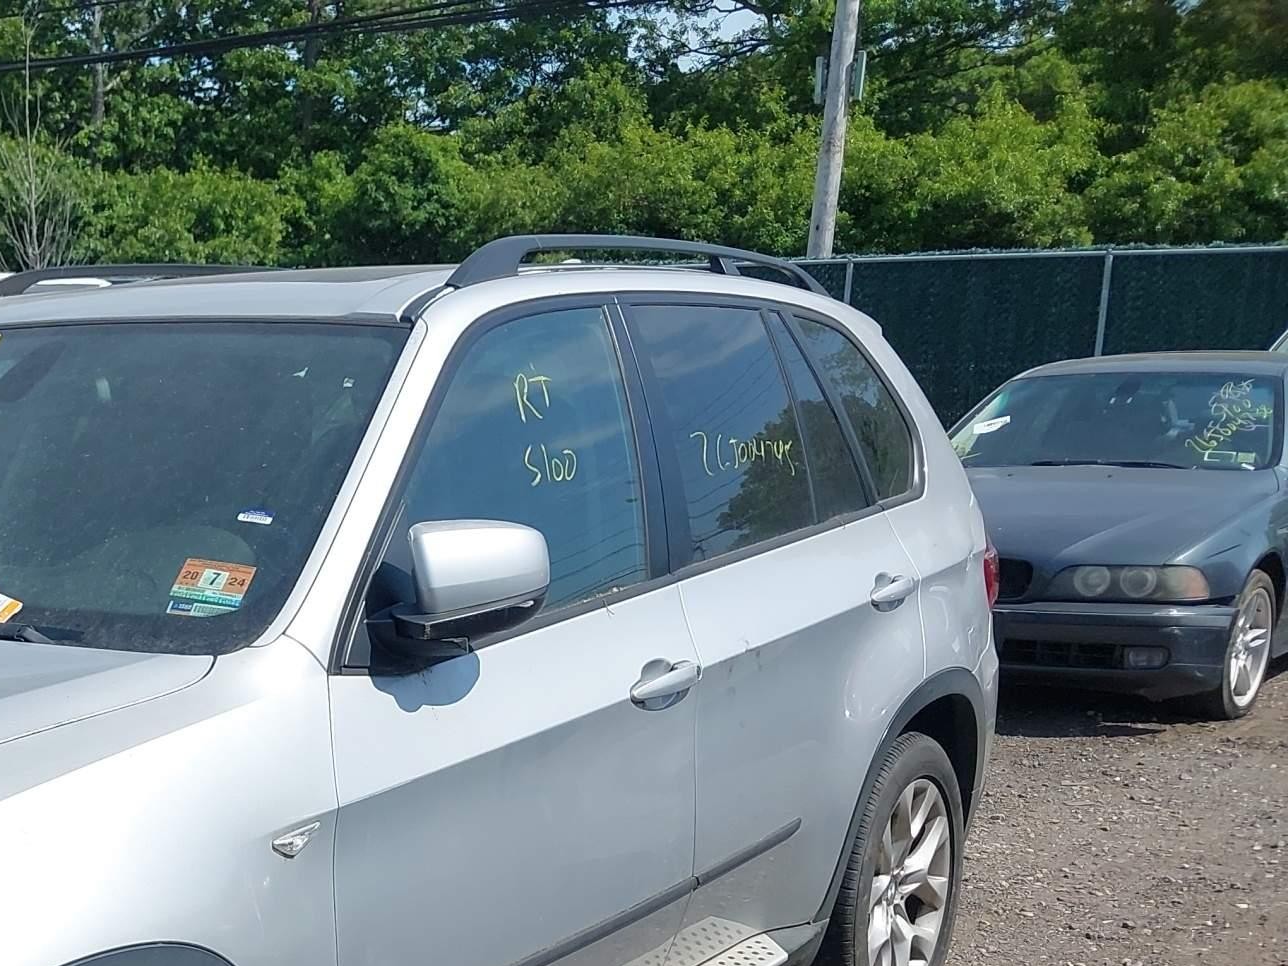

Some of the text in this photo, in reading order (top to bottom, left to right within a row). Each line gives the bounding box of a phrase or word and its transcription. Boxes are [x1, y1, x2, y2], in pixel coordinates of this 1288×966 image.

[183, 570, 246, 588] 20 7 24
